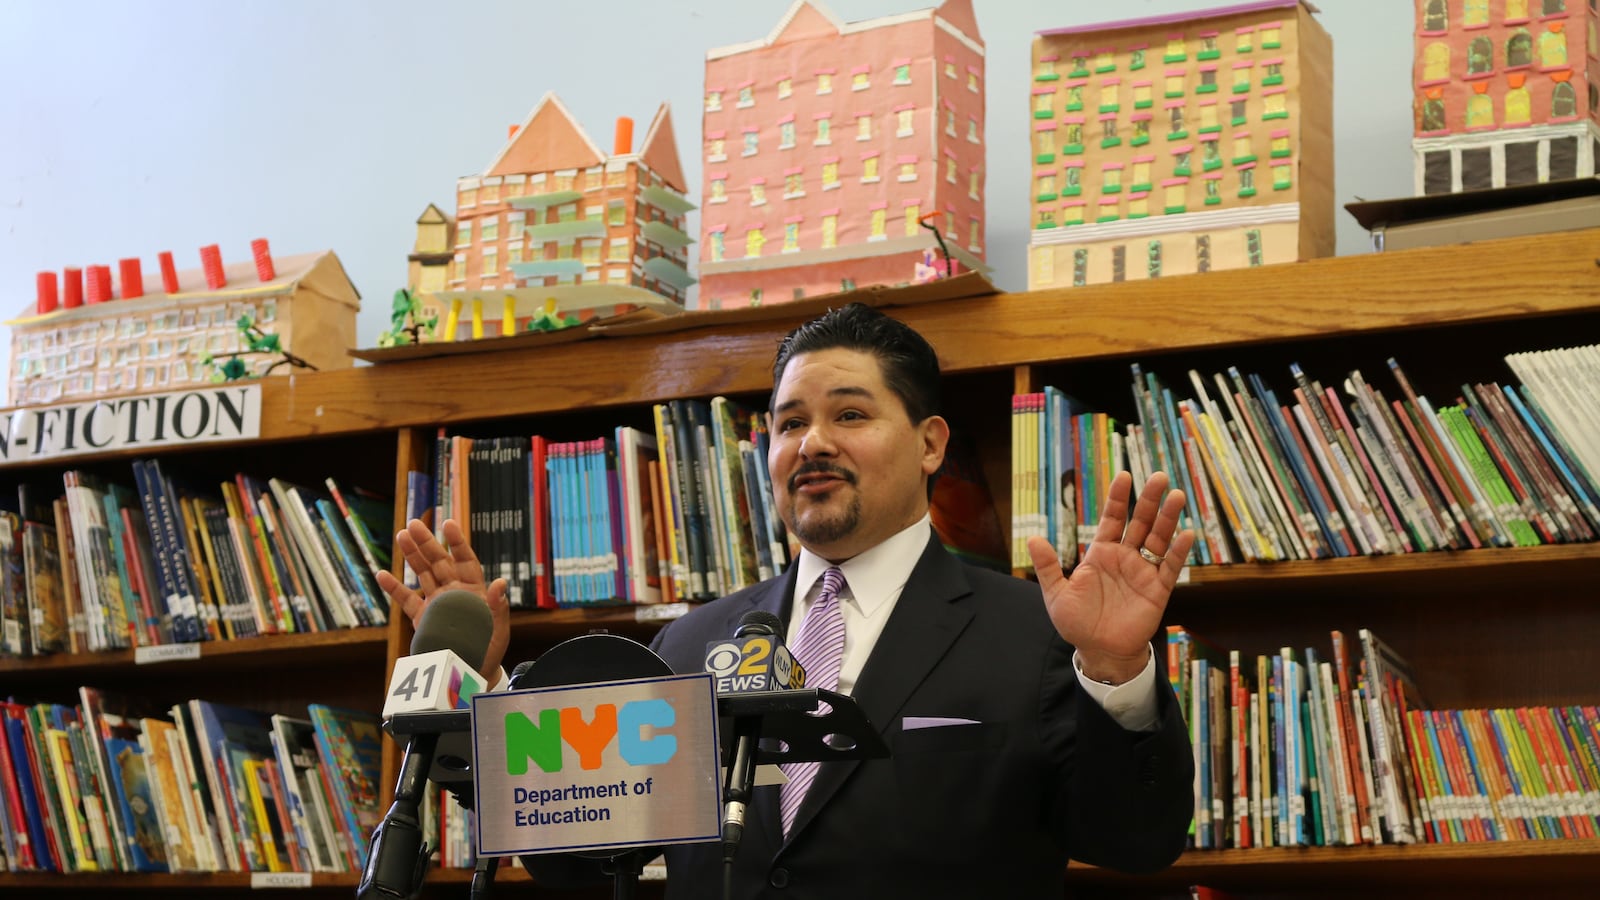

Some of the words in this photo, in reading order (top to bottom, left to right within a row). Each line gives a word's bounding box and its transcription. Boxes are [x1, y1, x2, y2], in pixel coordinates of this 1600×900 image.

[737, 638, 771, 676] 2
[775, 655, 791, 678] WLNY
[392, 664, 437, 702] 41
[716, 674, 766, 693] EWS
[504, 697, 678, 776] NYC
[513, 780, 628, 806] Department
[633, 777, 653, 795] of
[515, 806, 611, 827] Education
